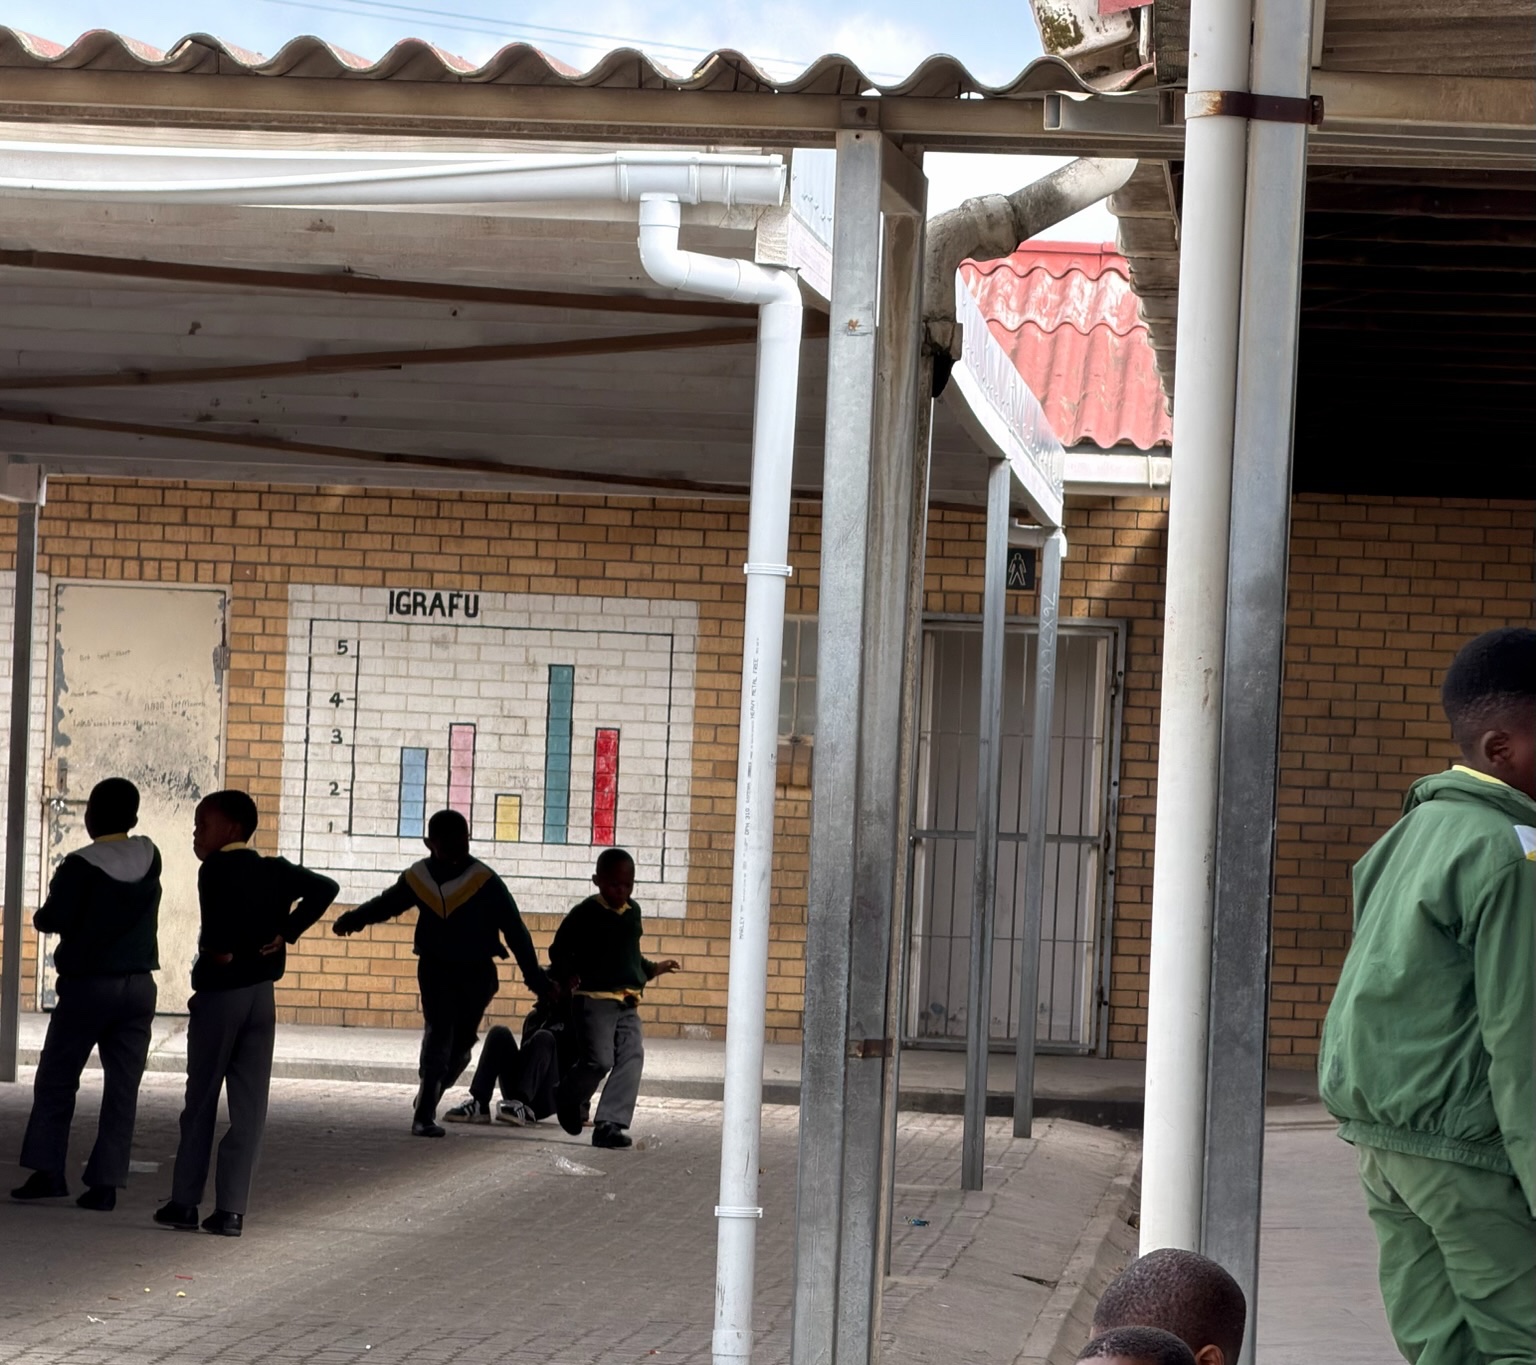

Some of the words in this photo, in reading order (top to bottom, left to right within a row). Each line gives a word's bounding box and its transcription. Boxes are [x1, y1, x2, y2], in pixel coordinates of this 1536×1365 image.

[389, 590, 479, 618] IGRAFU
[336, 639, 348, 655] 5
[329, 692, 344, 708] 4
[331, 729, 343, 744] 3
[329, 781, 340, 796] 2
[328, 821, 334, 834] 1
